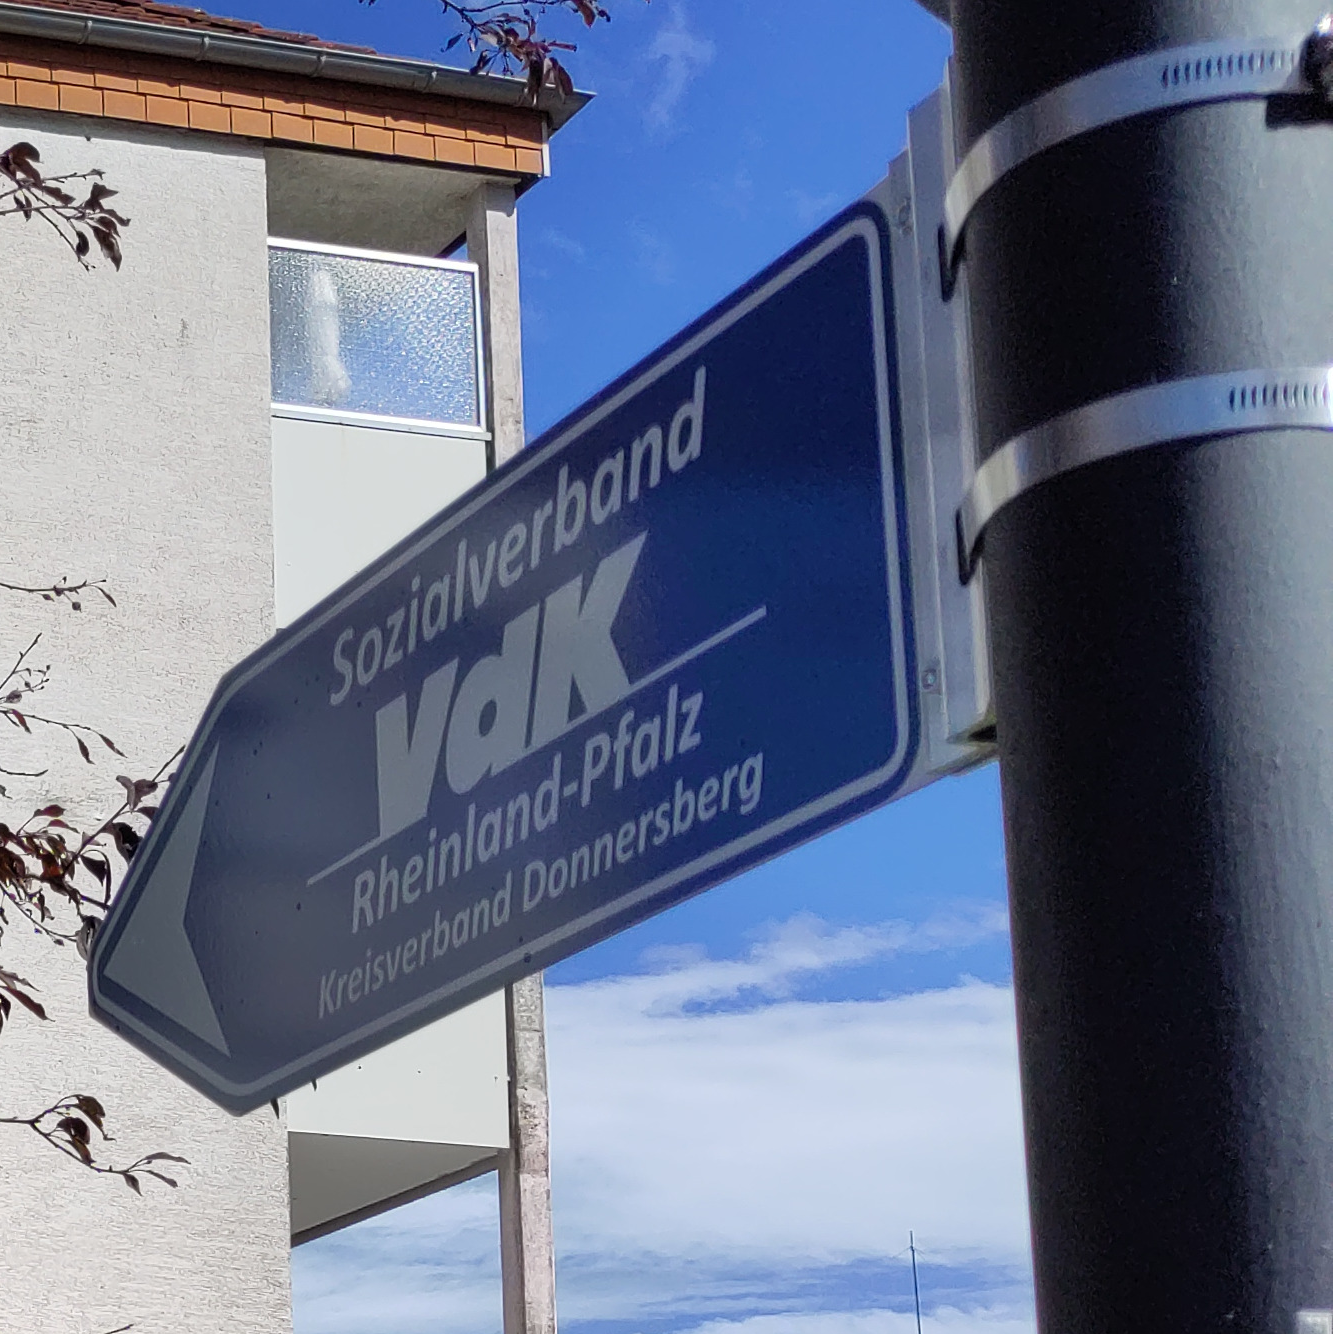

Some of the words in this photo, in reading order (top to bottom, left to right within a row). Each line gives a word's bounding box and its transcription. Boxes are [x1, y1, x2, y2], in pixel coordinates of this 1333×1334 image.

[329, 364, 706, 705] Sozialverband
[351, 683, 704, 934] Rheinland-Pfalz
[375, 530, 649, 838] VdK
[318, 872, 513, 1019] Kreisverband
[522, 751, 765, 913] Donnersberg
